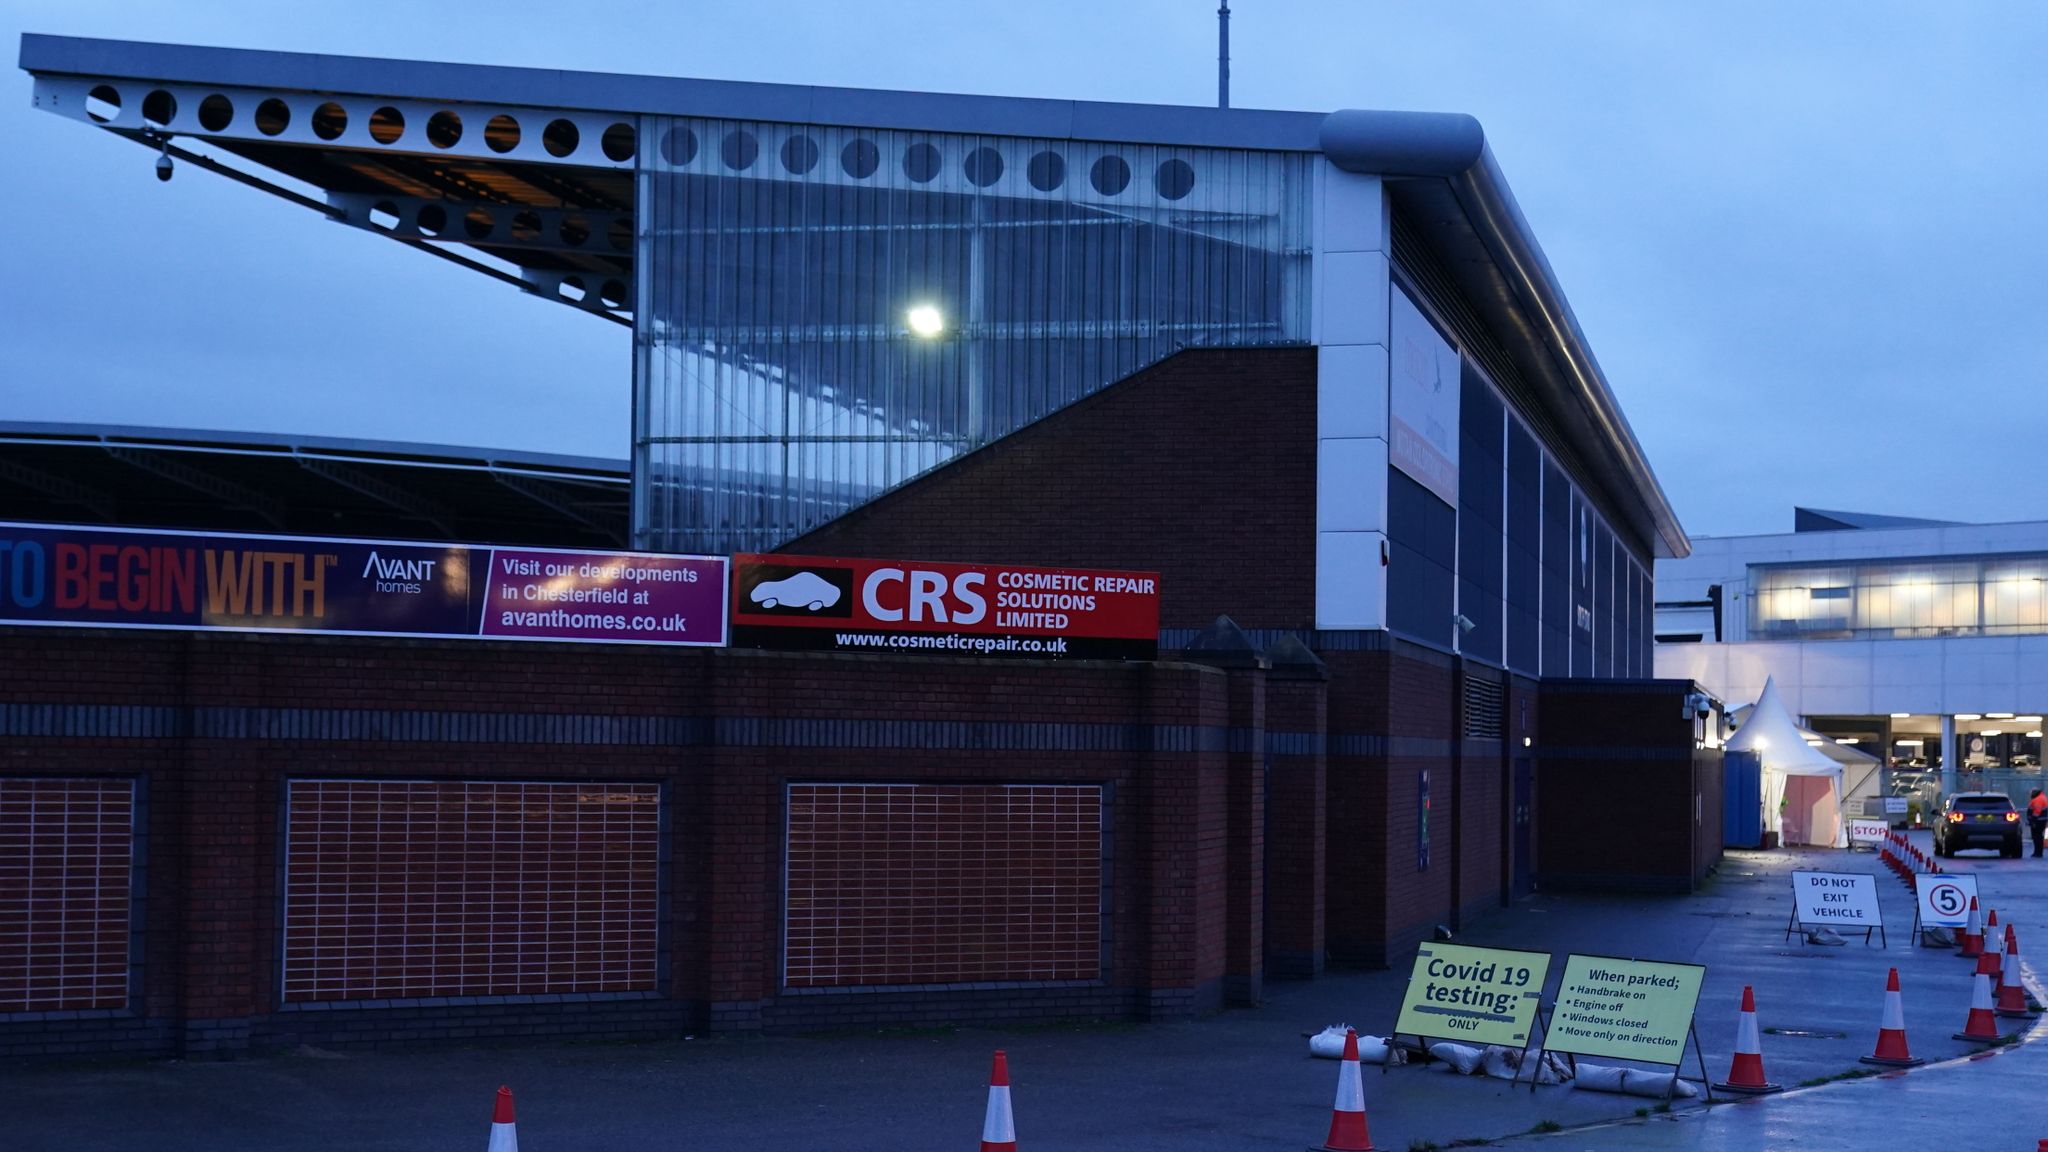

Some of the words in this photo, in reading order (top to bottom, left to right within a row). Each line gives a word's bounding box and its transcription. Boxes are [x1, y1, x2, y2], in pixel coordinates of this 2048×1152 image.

[362, 551, 436, 581] AVANT
[502, 559, 541, 576] Visit
[545, 563, 575, 577] our
[579, 563, 698, 584] developments
[55, 543, 196, 613] BEGIN
[376, 580, 421, 594] homes
[997, 572, 1089, 592] COSMETIC
[1094, 576, 1155, 594] REPAIR
[502, 584, 518, 599] in
[523, 584, 628, 604] Chesterfield
[633, 590, 649, 605] at
[862, 568, 987, 625] CRS
[997, 592, 1096, 611] SOLUTIONS
[501, 609, 687, 632] avanthomes.co.uk
[996, 611, 1069, 629] LIMITED
[835, 632, 1068, 654] www.cosmeticrepair.co.uk
[1854, 825, 1887, 836] STOP
[1811, 877, 1829, 887] DO
[1832, 878, 1856, 888] NOT
[1823, 893, 1849, 902] EXIT
[1940, 889, 1957, 911] 5
[1813, 907, 1864, 918] VEHICLE
[1427, 958, 1497, 983] Covid
[1500, 967, 1530, 987] 19
[1589, 969, 1625, 983] When
[1627, 974, 1680, 991] parked;
[1425, 982, 1519, 1014] testing:
[1577, 985, 1631, 999] Handbrake
[1633, 991, 1646, 1000] on
[1573, 999, 1606, 1011] Engine
[1608, 1003, 1623, 1012] off
[1448, 1018, 1480, 1031] ONLY
[1569, 1013, 1614, 1026] Windows
[1615, 1018, 1648, 1029] closed
[1565, 1026, 1591, 1038] Move
[1593, 1030, 1615, 1041] only
[1617, 1033, 1630, 1041] on
[1632, 1033, 1678, 1046] direction
